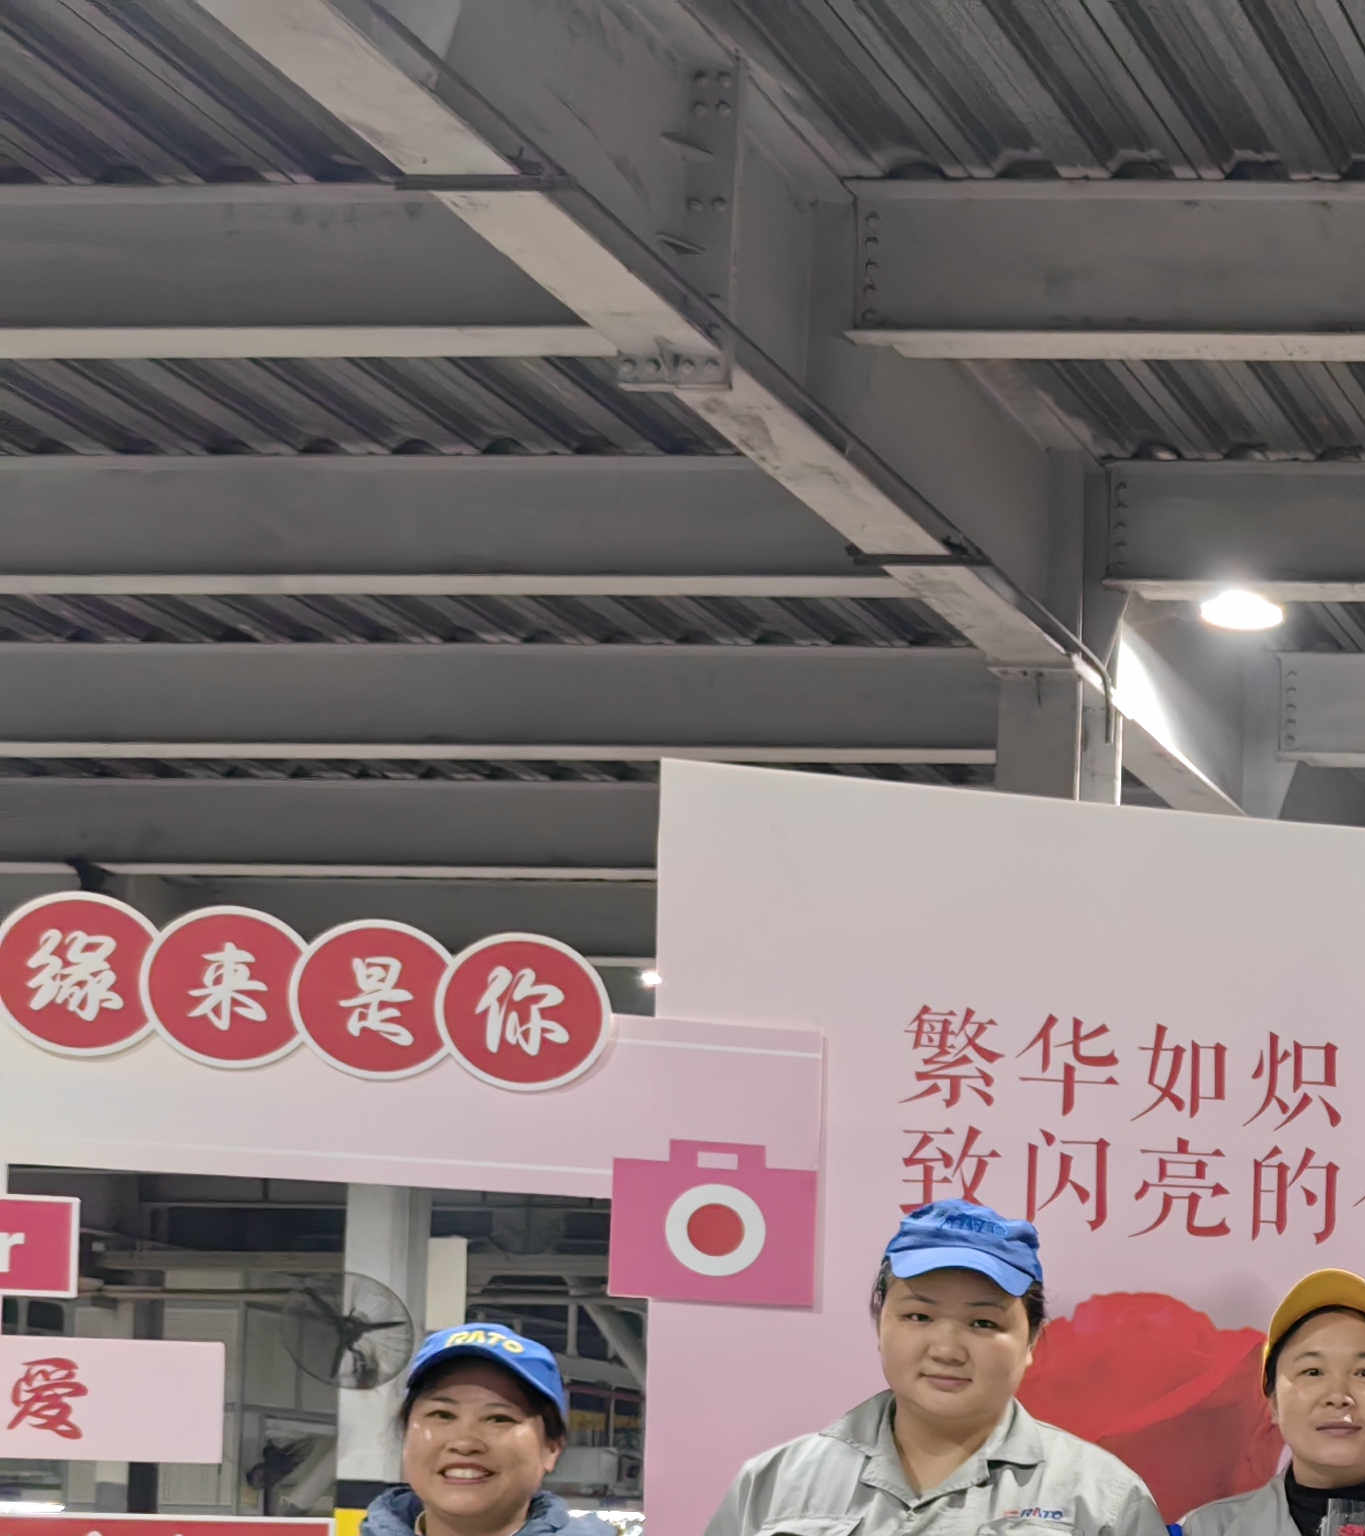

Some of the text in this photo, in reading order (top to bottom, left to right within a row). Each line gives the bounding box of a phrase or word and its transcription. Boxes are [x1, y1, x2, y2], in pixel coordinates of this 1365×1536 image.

[898, 1004, 1344, 1132] 繁华如炽
[445, 1330, 524, 1354] RATO
[7, 1356, 89, 1441] 爱
[1020, 1507, 1064, 1519] RATO
